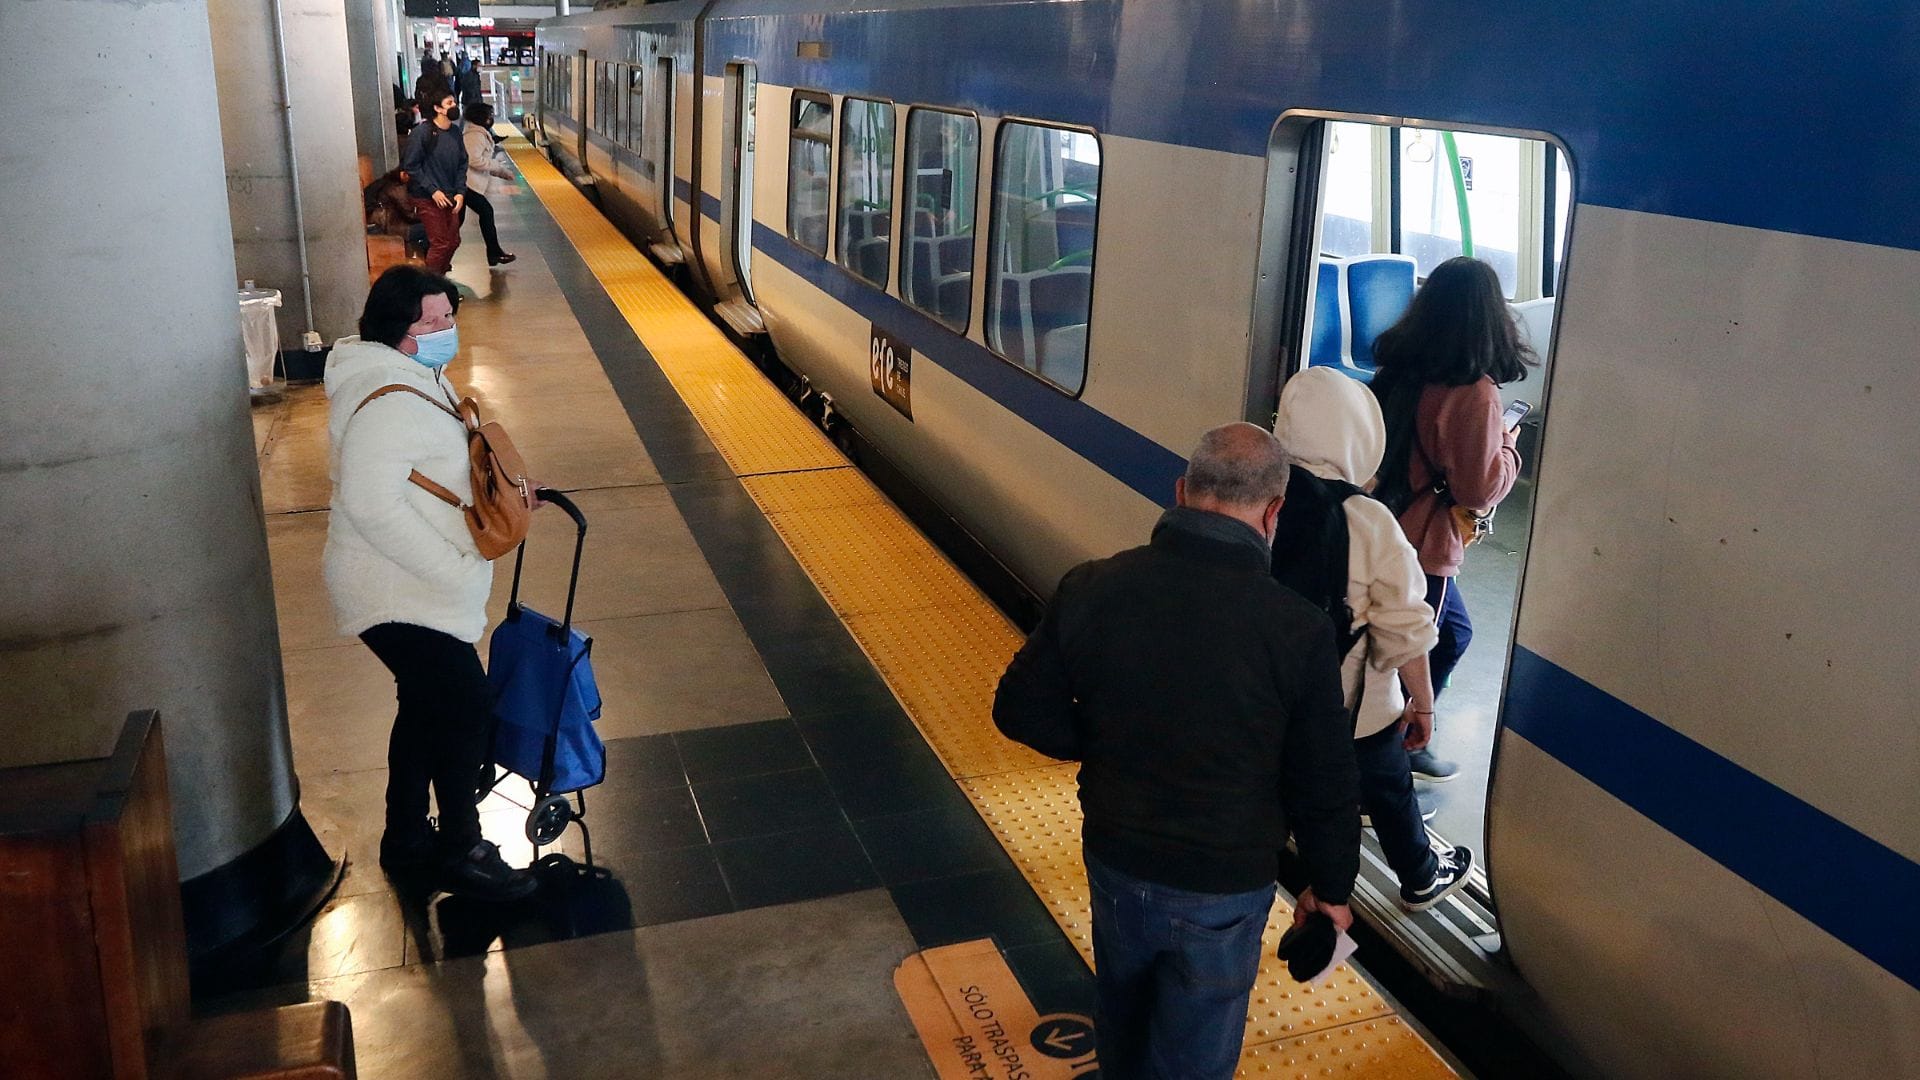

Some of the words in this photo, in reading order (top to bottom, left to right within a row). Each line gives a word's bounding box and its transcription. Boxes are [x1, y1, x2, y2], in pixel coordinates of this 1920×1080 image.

[872, 337, 894, 394] efe
[960, 985, 994, 1020] SÓLO
[952, 1035, 988, 1075] PARA
